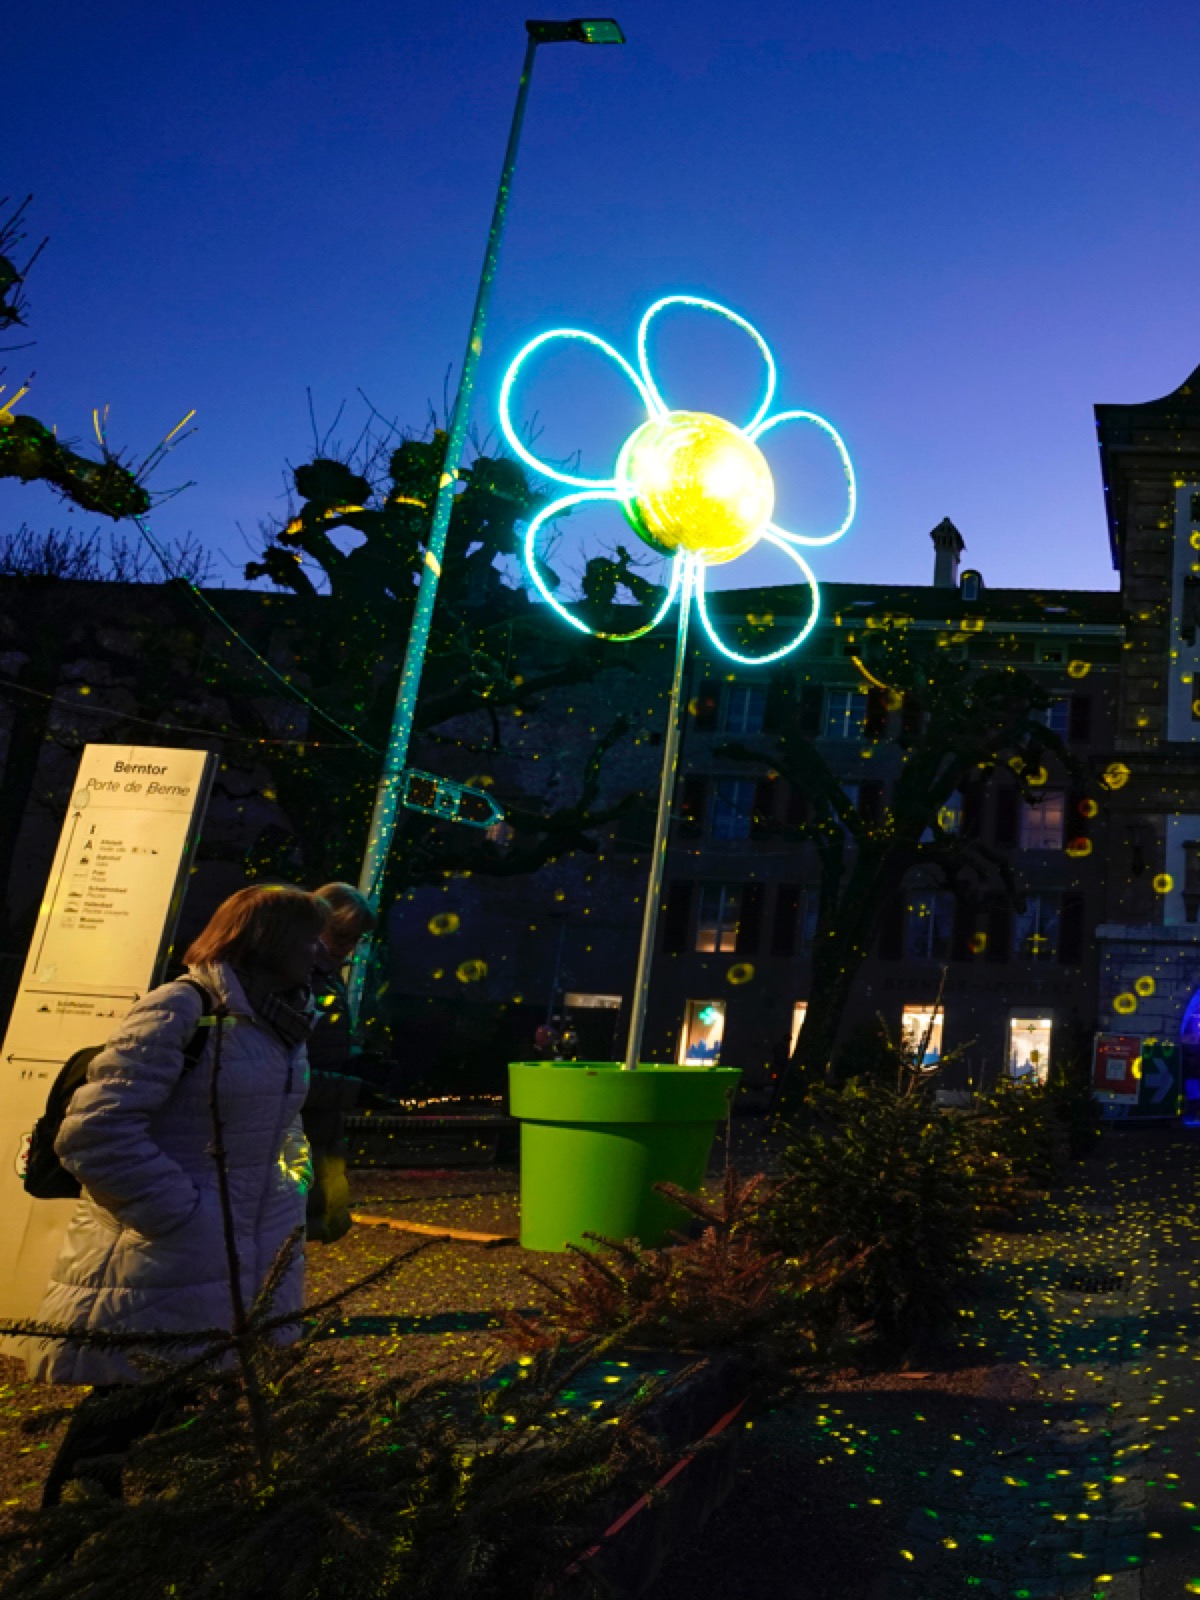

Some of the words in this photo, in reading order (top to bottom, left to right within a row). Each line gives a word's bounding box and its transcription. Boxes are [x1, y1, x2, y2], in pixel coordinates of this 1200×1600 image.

[113, 761, 168, 775] Berntor
[86, 777, 120, 792] Porte
[123, 780, 142, 793] de
[146, 781, 191, 796] Berne
